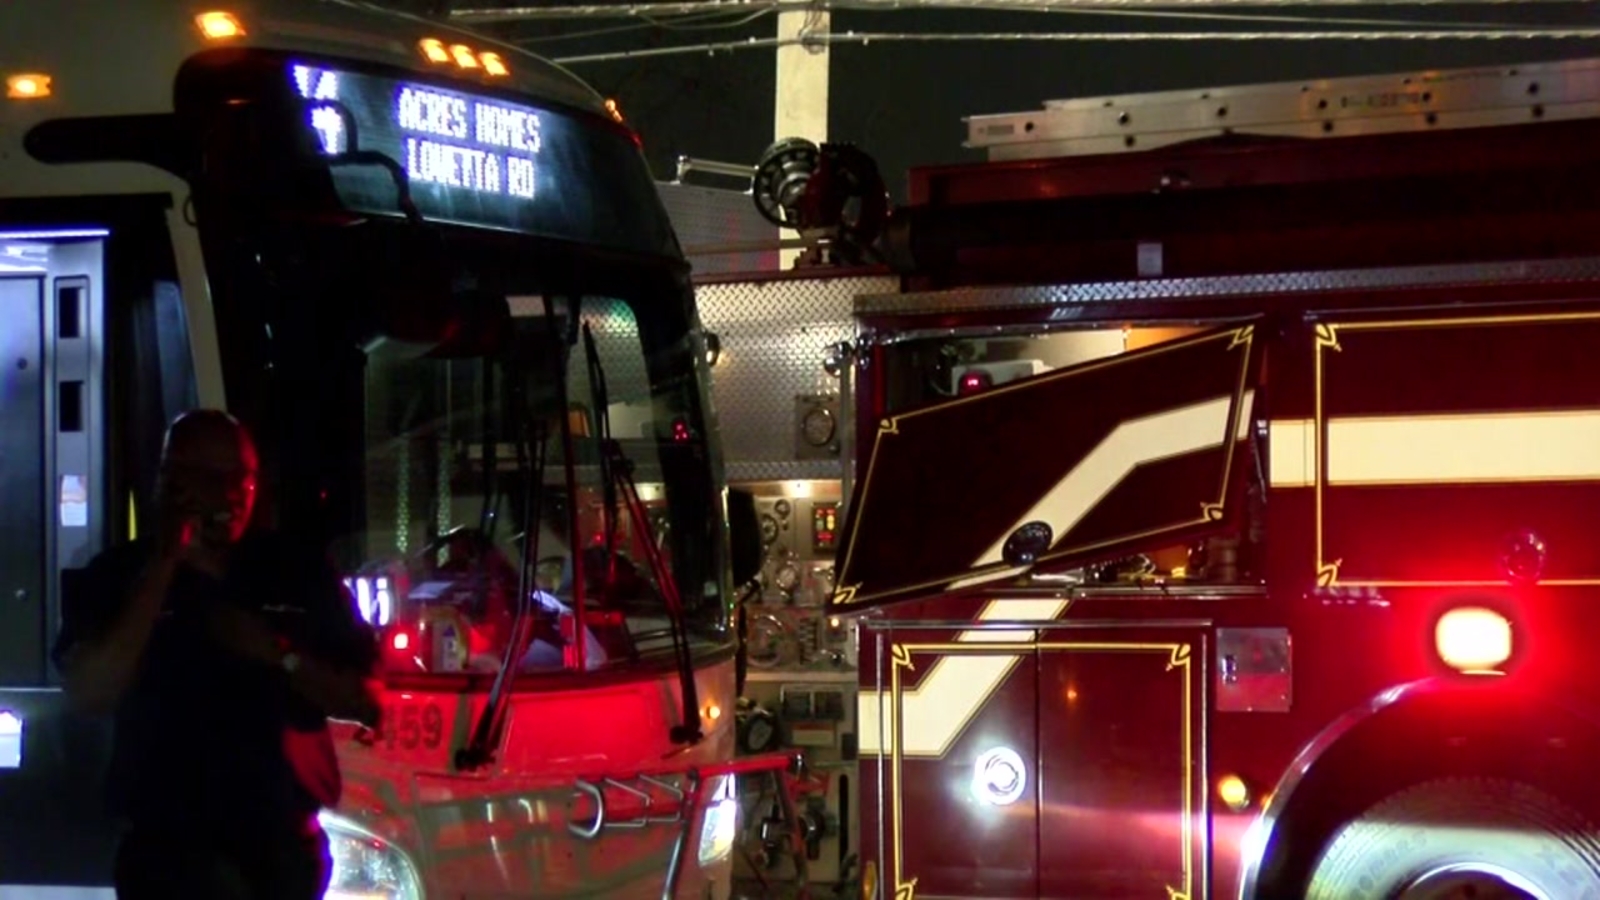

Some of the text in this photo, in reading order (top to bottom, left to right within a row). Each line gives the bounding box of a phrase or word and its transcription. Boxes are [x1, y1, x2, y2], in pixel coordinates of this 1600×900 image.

[399, 87, 542, 153] ACRES HOMES
[406, 136, 536, 199] LOUETTA RD
